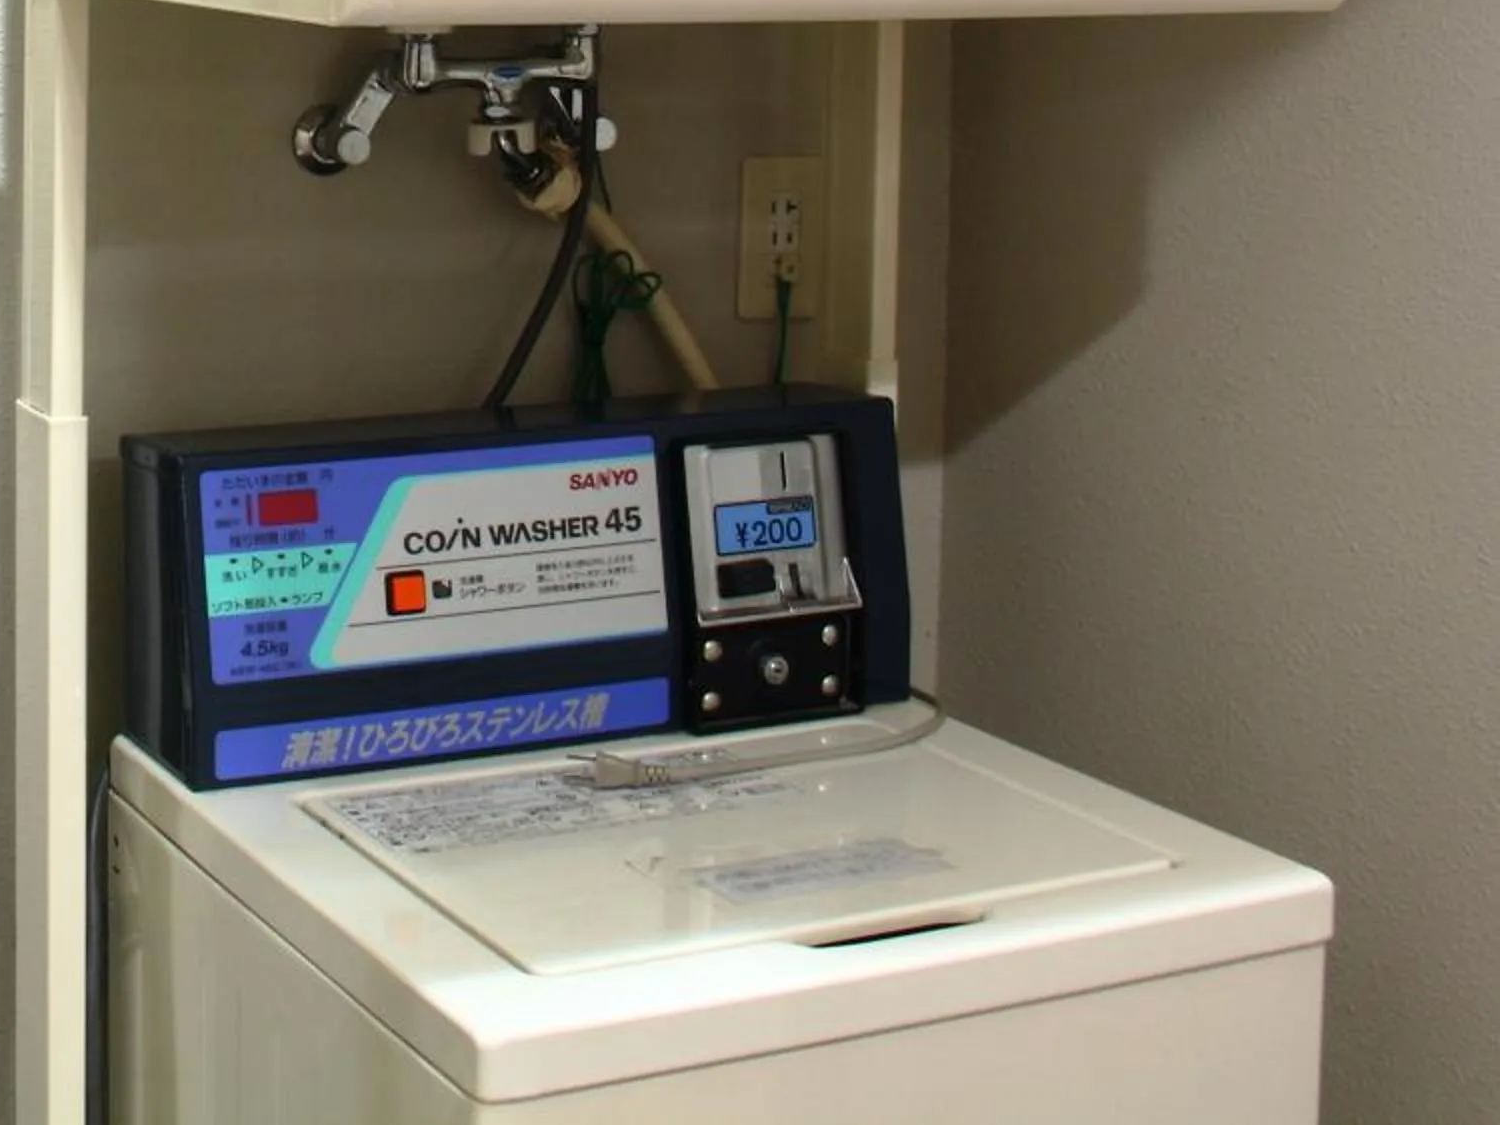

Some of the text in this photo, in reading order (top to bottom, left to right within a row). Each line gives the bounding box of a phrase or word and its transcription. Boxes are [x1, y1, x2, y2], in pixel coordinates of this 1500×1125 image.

[569, 468, 638, 491] SANYO
[488, 514, 599, 547] WASHER
[604, 506, 642, 533] 45
[735, 516, 803, 549] ¥200
[457, 583, 527, 599] シャワーボタン
[240, 639, 290, 658] 4.5kg
[283, 694, 609, 768] 清潔!ひろびろステンレス槽
